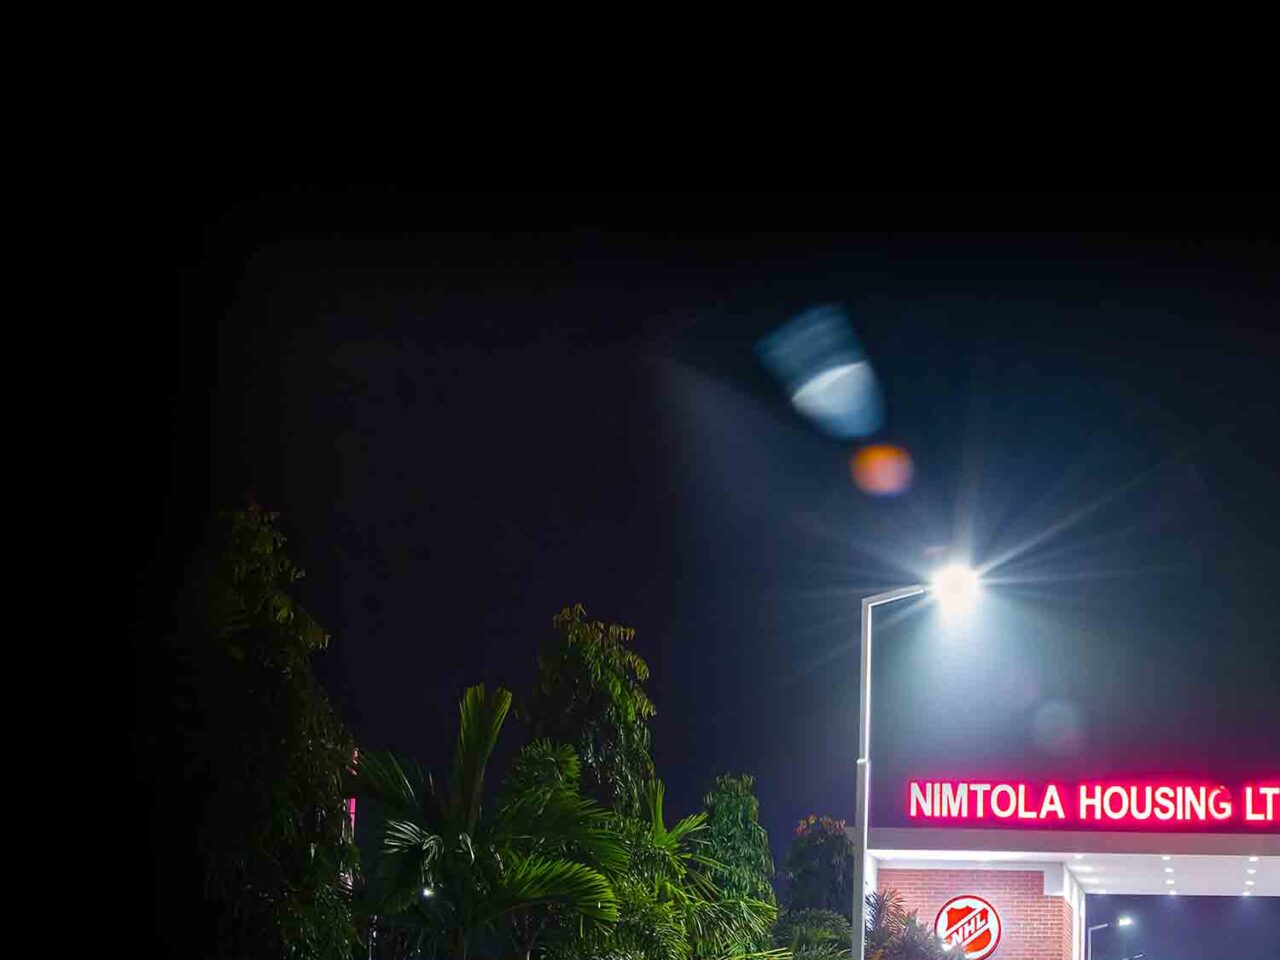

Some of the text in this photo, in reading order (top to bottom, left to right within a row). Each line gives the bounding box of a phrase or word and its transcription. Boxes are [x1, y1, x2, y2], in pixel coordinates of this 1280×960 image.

[910, 783, 1065, 819] NIMTOLA
[1079, 785, 1232, 820] HOUSING
[951, 913, 987, 946] NHL
